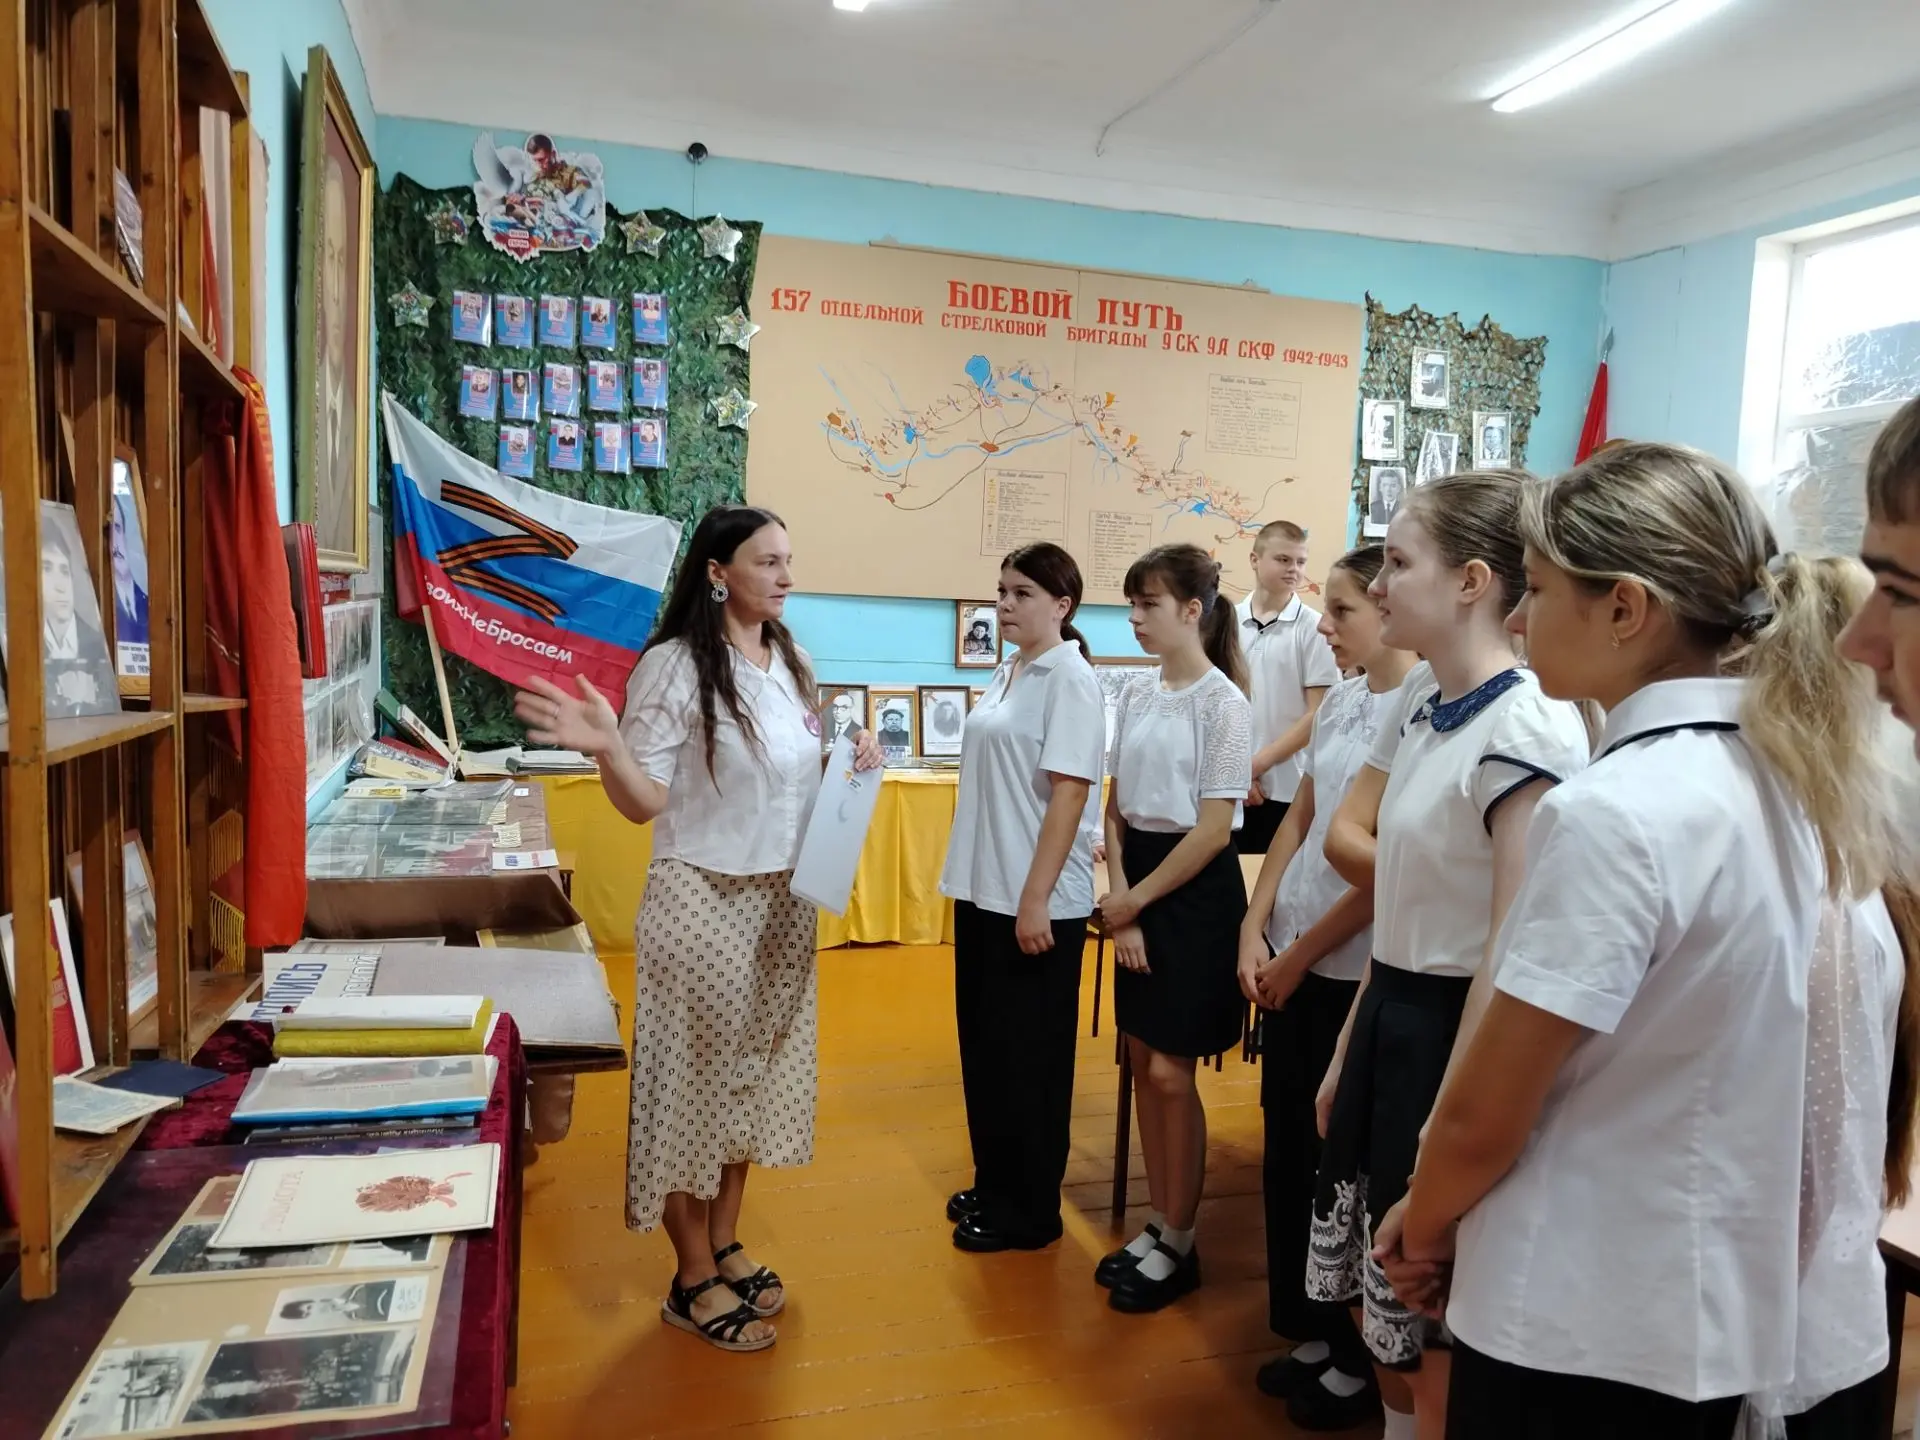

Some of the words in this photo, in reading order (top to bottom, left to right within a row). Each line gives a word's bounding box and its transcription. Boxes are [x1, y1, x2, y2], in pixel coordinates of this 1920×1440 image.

[771, 288, 812, 313] 157
[820, 299, 925, 326] ОТДЕЛЬНОЙ
[941, 312, 1048, 338] СТРЕЛКОВОЙ
[1066, 326, 1147, 349] БРИГАДЫ
[1238, 340, 1275, 361] СКФ
[1283, 348, 1349, 369] 1942-1943
[948, 280, 1073, 321] БОЕВОЙ
[1098, 298, 1184, 331] ПУТЬ
